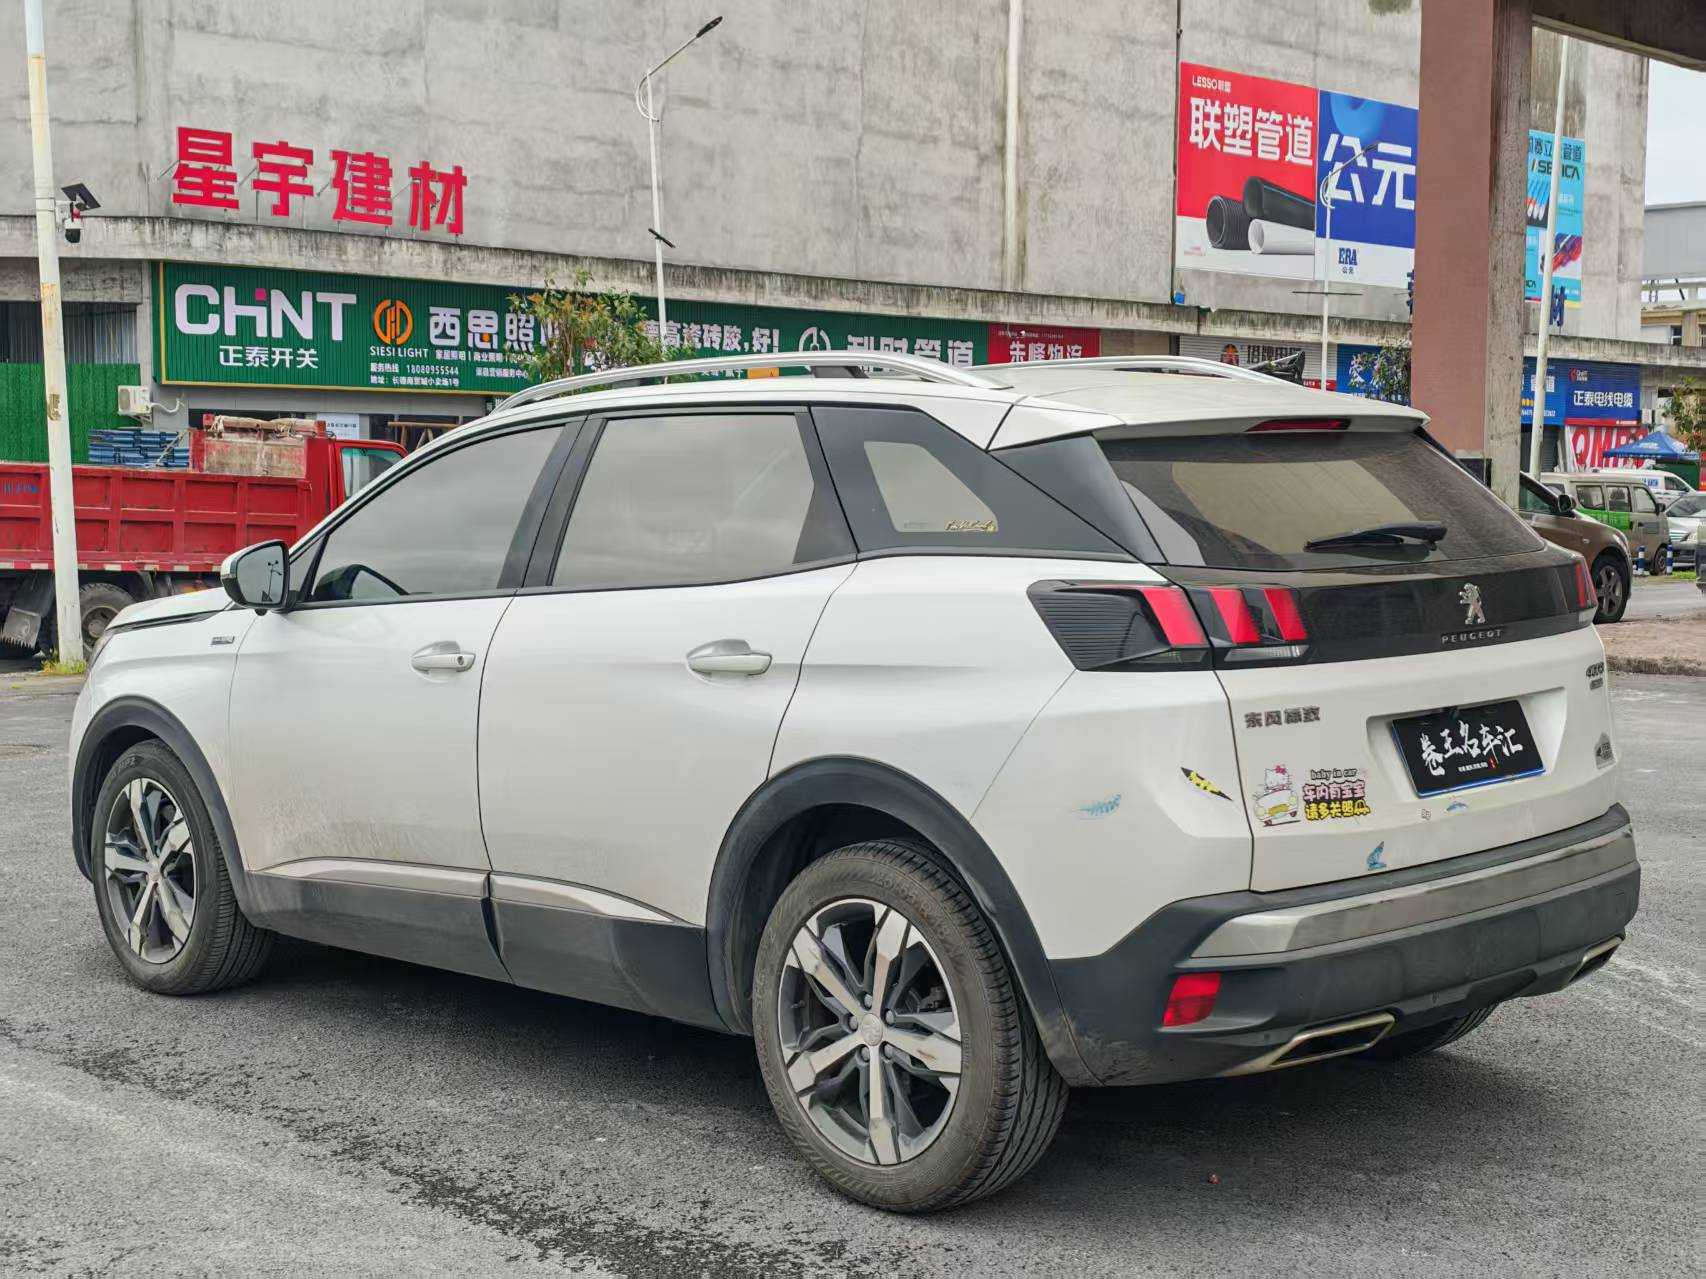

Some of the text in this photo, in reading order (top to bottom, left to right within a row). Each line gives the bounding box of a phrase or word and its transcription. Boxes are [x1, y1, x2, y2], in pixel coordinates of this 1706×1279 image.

[1192, 75, 1218, 90] LESSO
[1189, 96, 1313, 167] 联塑管道
[171, 126, 469, 235] 星宇建材
[1320, 132, 1416, 210] 公元
[1338, 247, 1358, 266] ERA
[218, 344, 319, 370] 正泰开关
[370, 345, 429, 358] SIESI LIGHT
[1573, 390, 1634, 408] 正泰电线电缆
[1441, 629, 1502, 645] PEUGEOT
[1244, 705, 1321, 729] 东风标致
[1310, 768, 1358, 781] baby in car
[1303, 780, 1366, 802] 车内有宝宝
[1304, 800, 1354, 821] 请多关照
